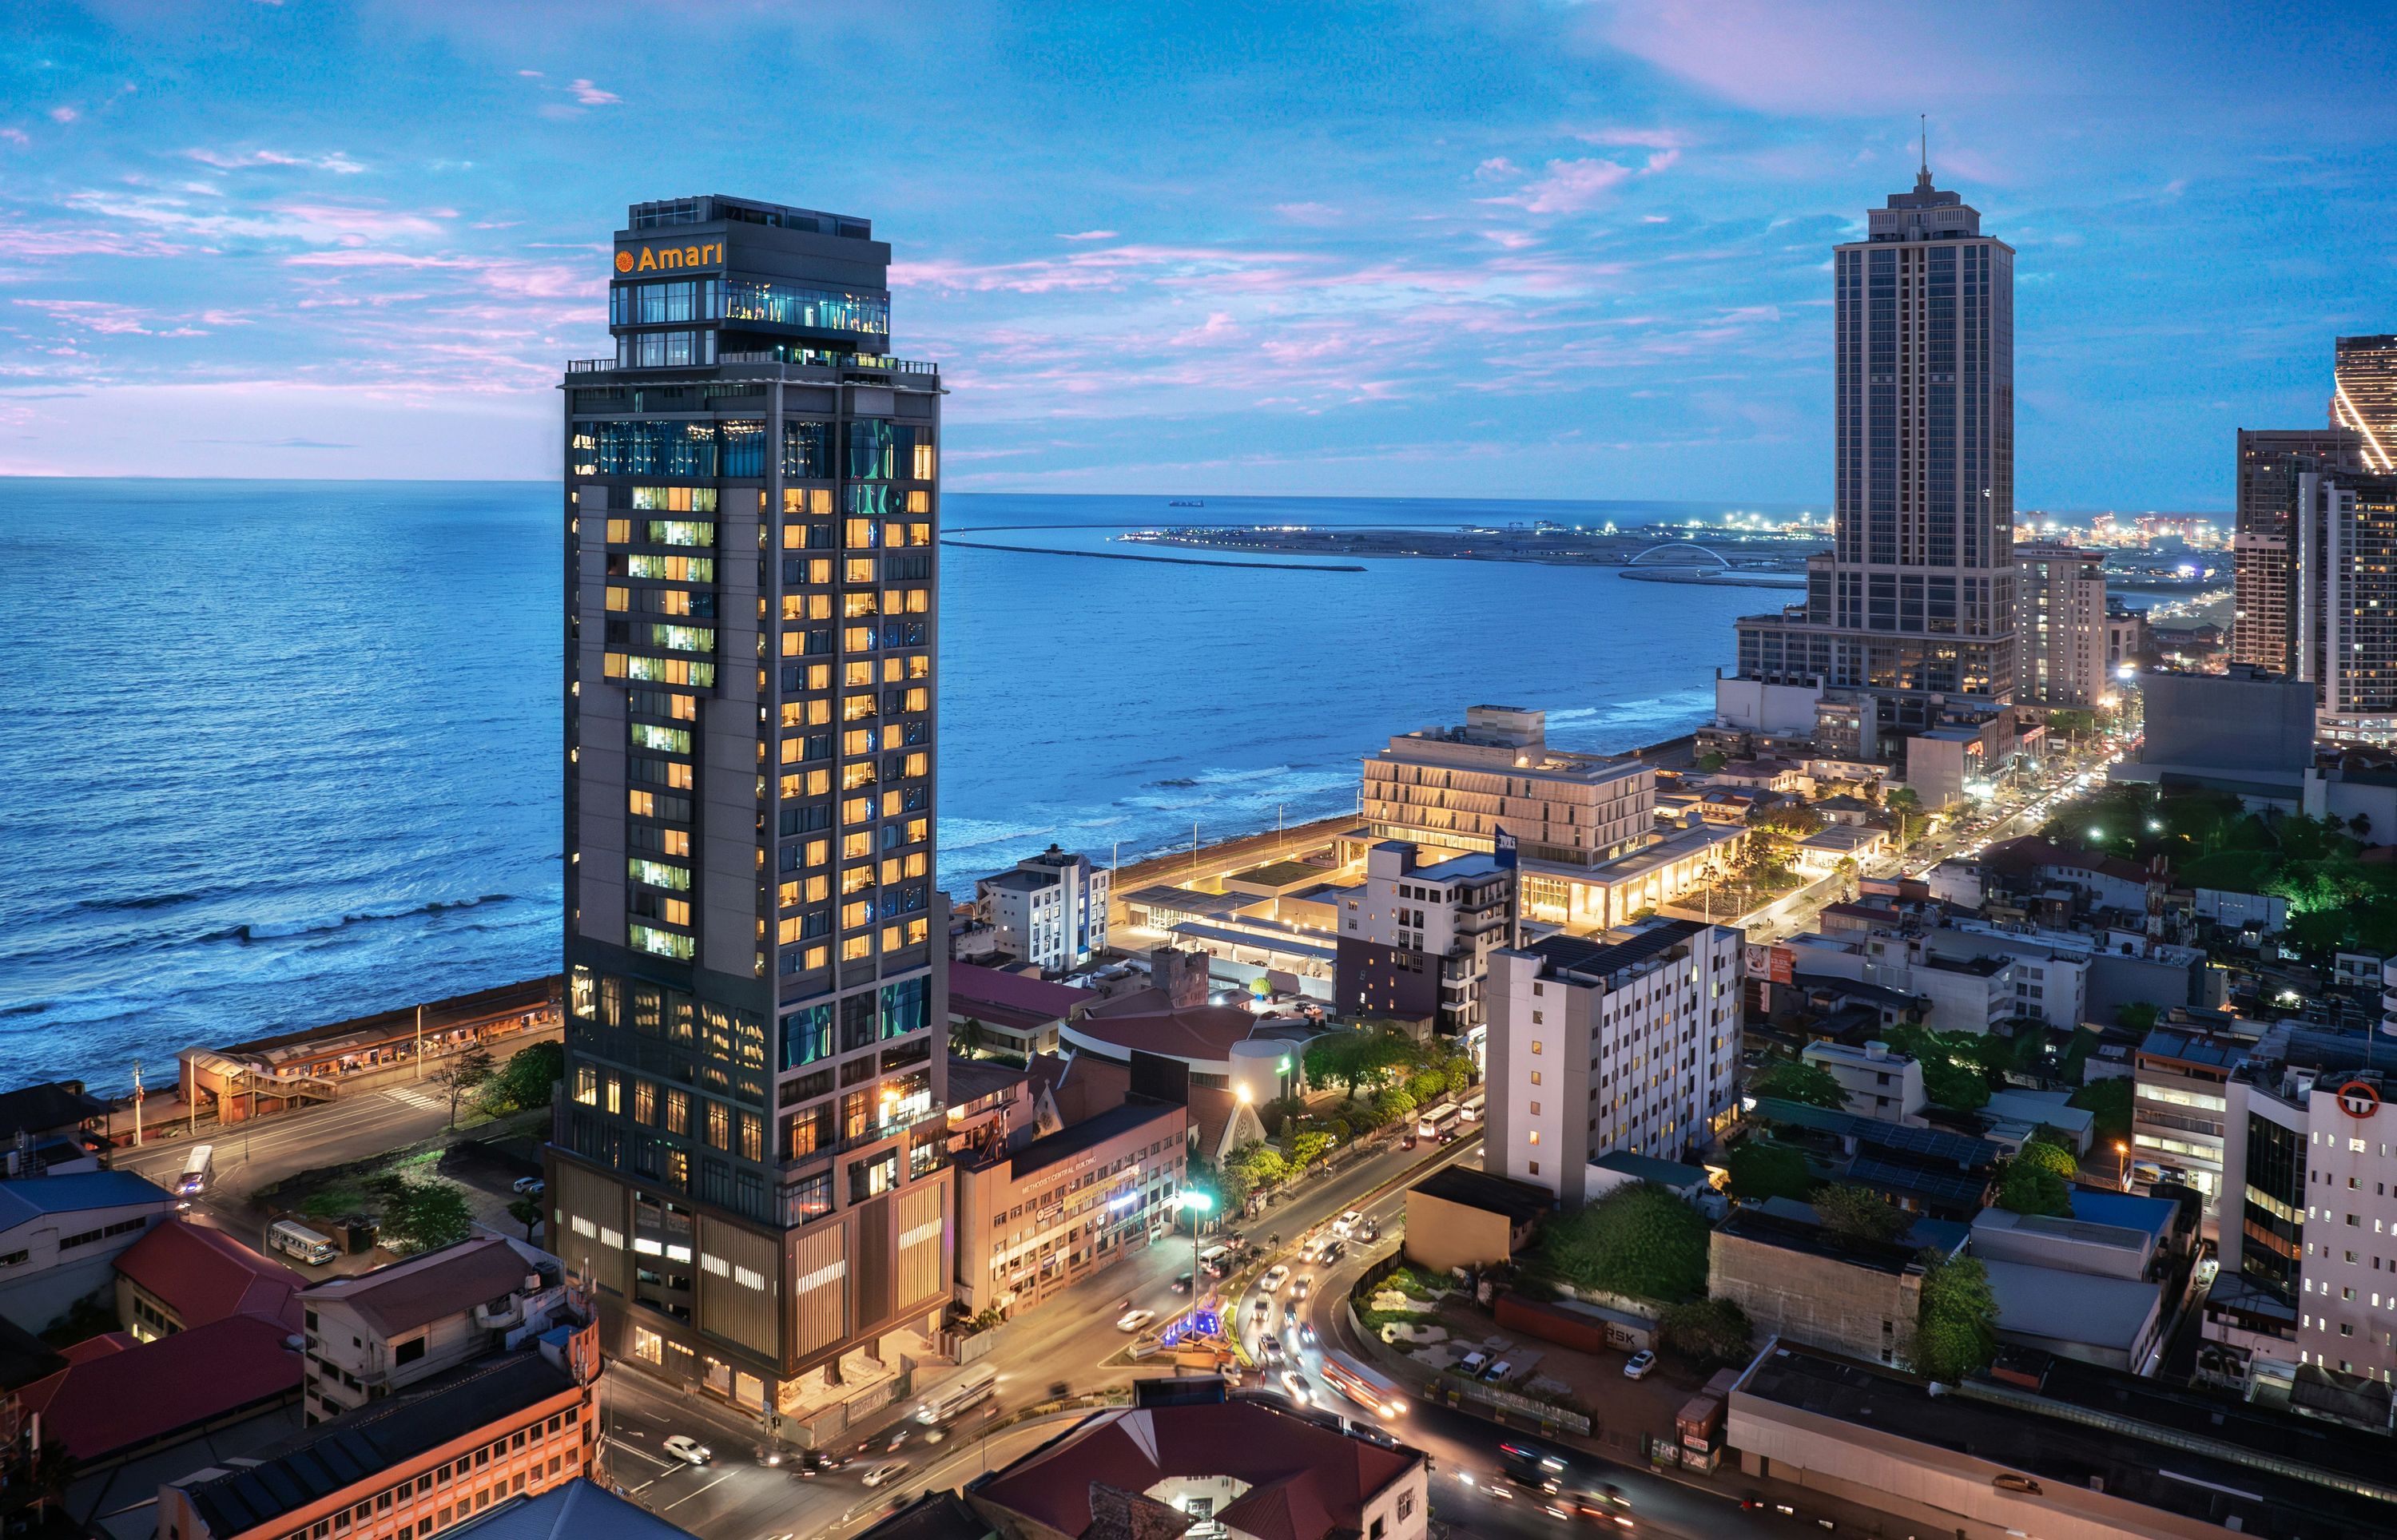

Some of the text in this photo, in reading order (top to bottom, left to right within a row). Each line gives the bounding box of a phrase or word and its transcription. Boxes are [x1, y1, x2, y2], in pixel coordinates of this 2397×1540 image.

[637, 242, 722, 272] Amari
[1022, 1156, 1097, 1195] METHODIST CENTRAL BUILDING
